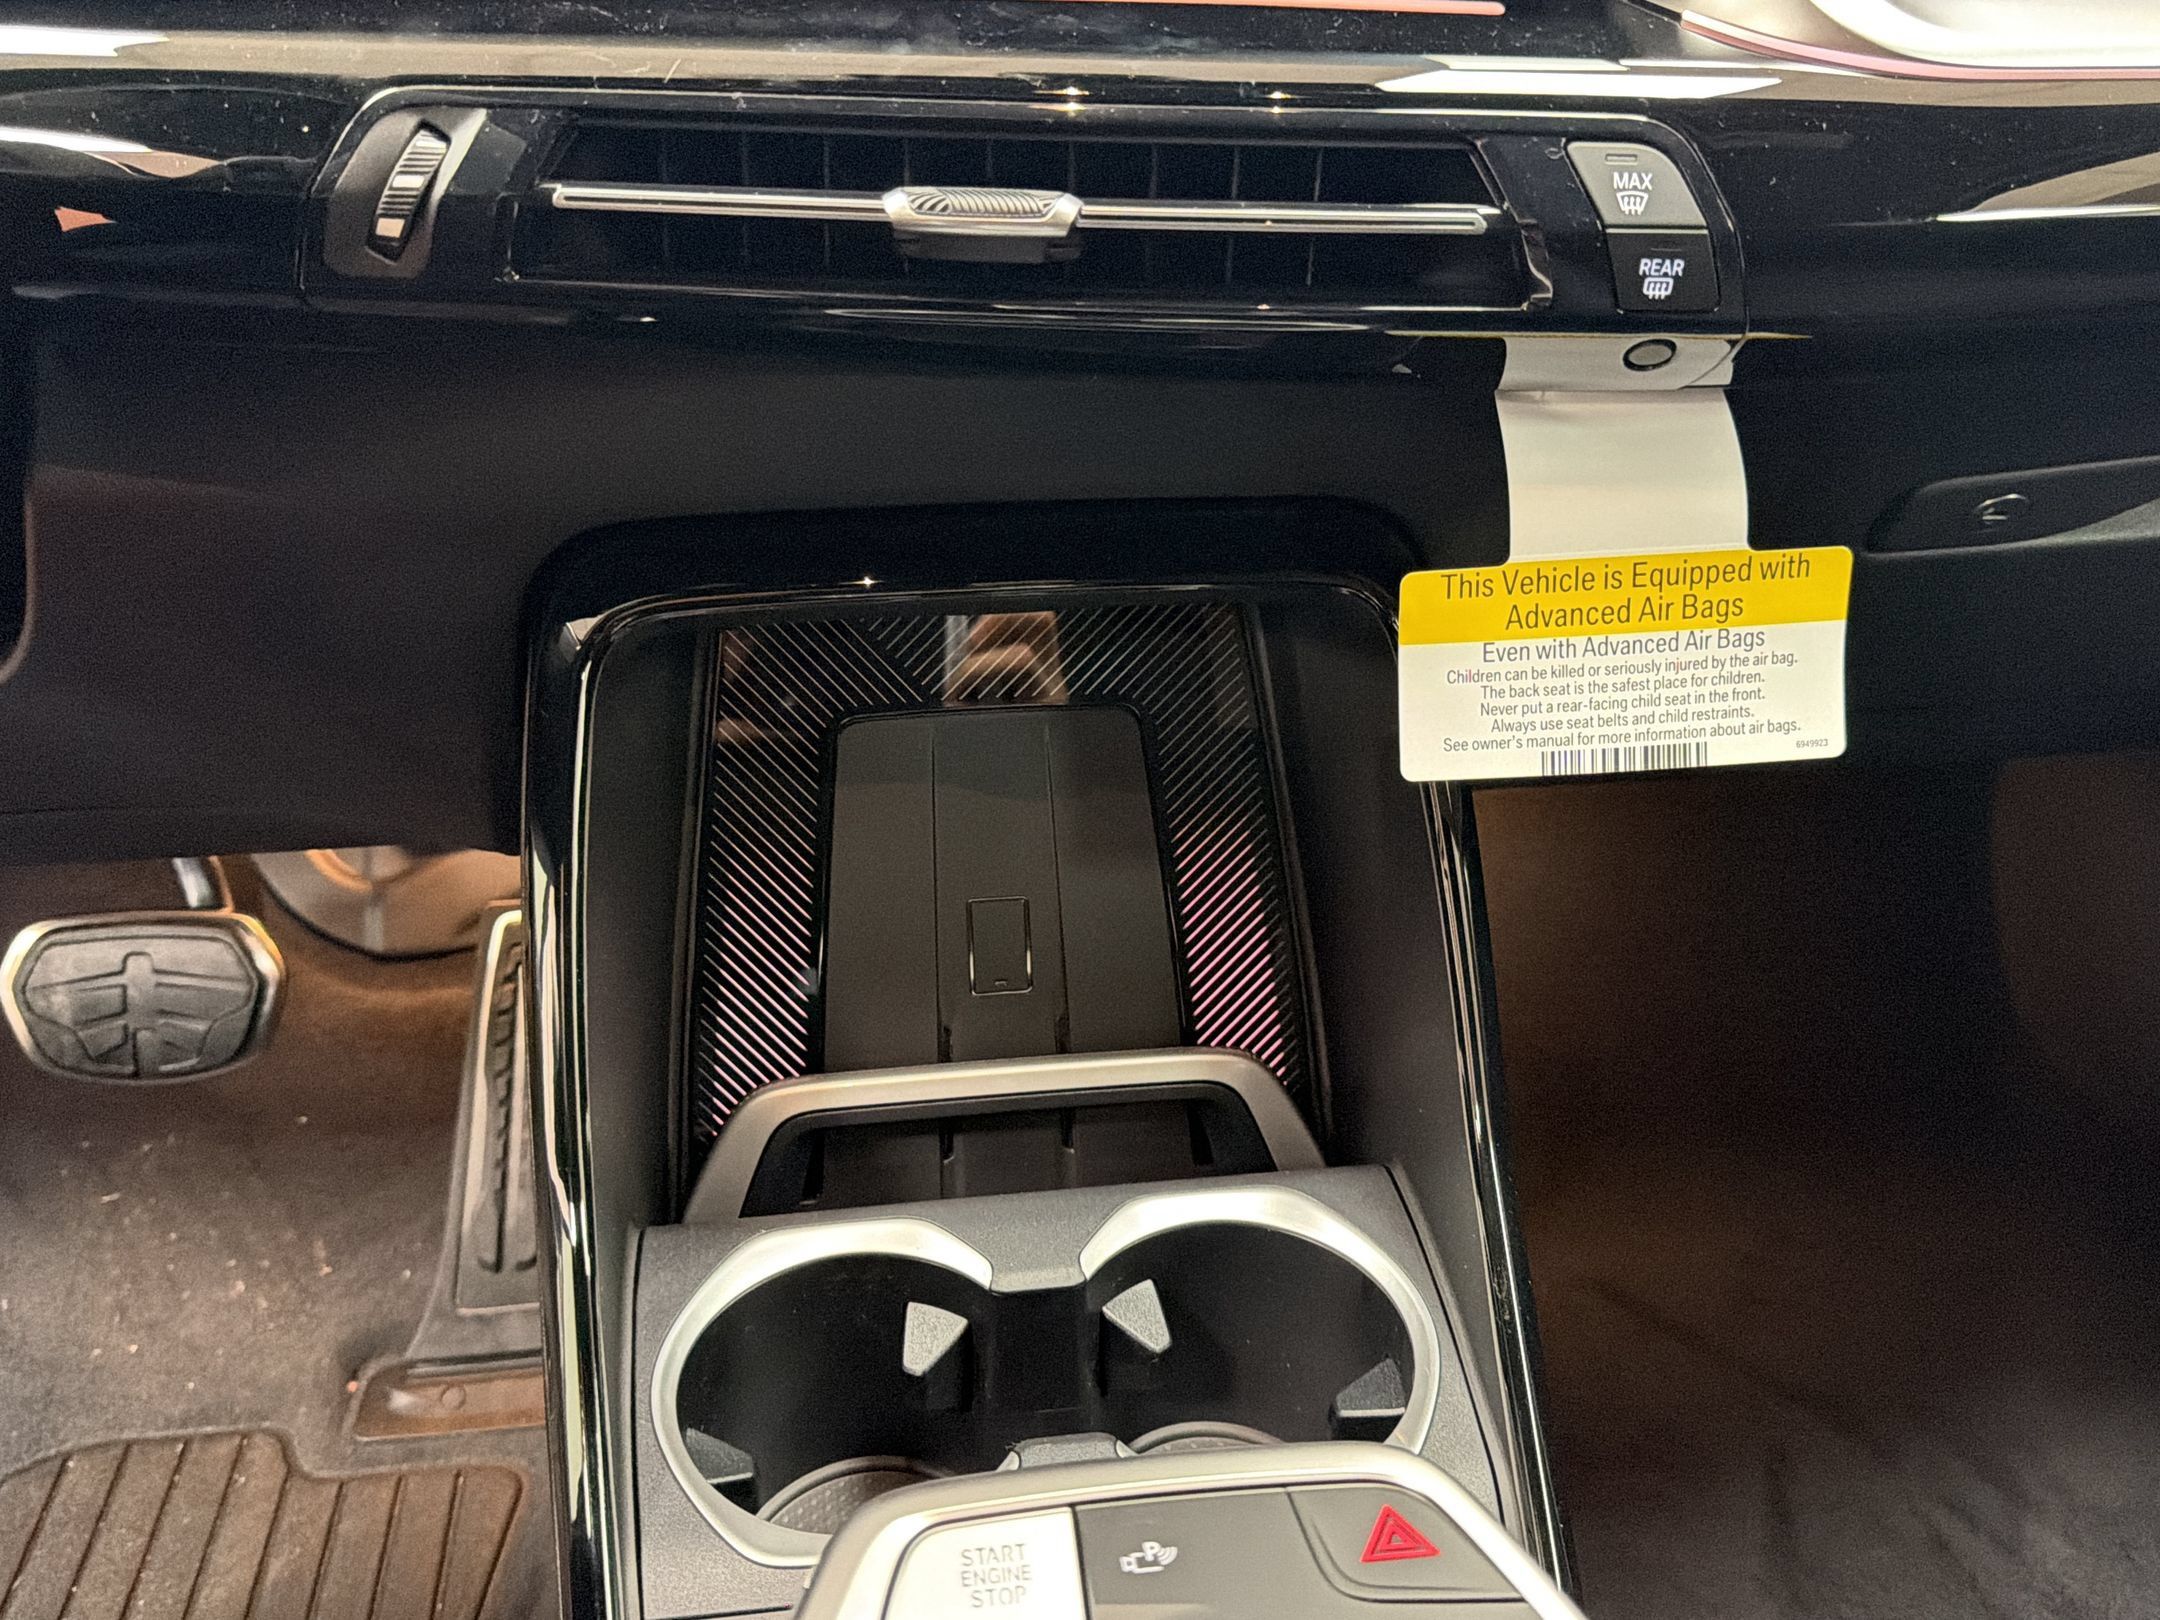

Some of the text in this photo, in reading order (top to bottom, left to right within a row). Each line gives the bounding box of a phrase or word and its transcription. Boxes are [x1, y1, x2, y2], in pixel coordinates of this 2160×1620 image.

[1614, 172, 1652, 190] MAX
[1639, 259, 1685, 276] REAR
[1441, 553, 1810, 599] This Vehicle is Equipped with
[1506, 594, 1744, 630] Advanced Air Bags
[1483, 628, 1765, 662] Even with Advanced Air Bags
[1447, 650, 1798, 684] Children can be killed or seriously injured by the air bag.
[1480, 671, 1765, 699] The back seat is the safest place for children.
[1480, 688, 1765, 717] Never put a rear-facing child seat in the front.
[1491, 705, 1754, 734] Always use seat belts and child restraints.
[1443, 719, 1801, 752] See owner's manual for more information about air bags.
[961, 1544, 1026, 1566] START
[961, 1565, 1032, 1587] ENGINE
[970, 1586, 1027, 1608] STOP
